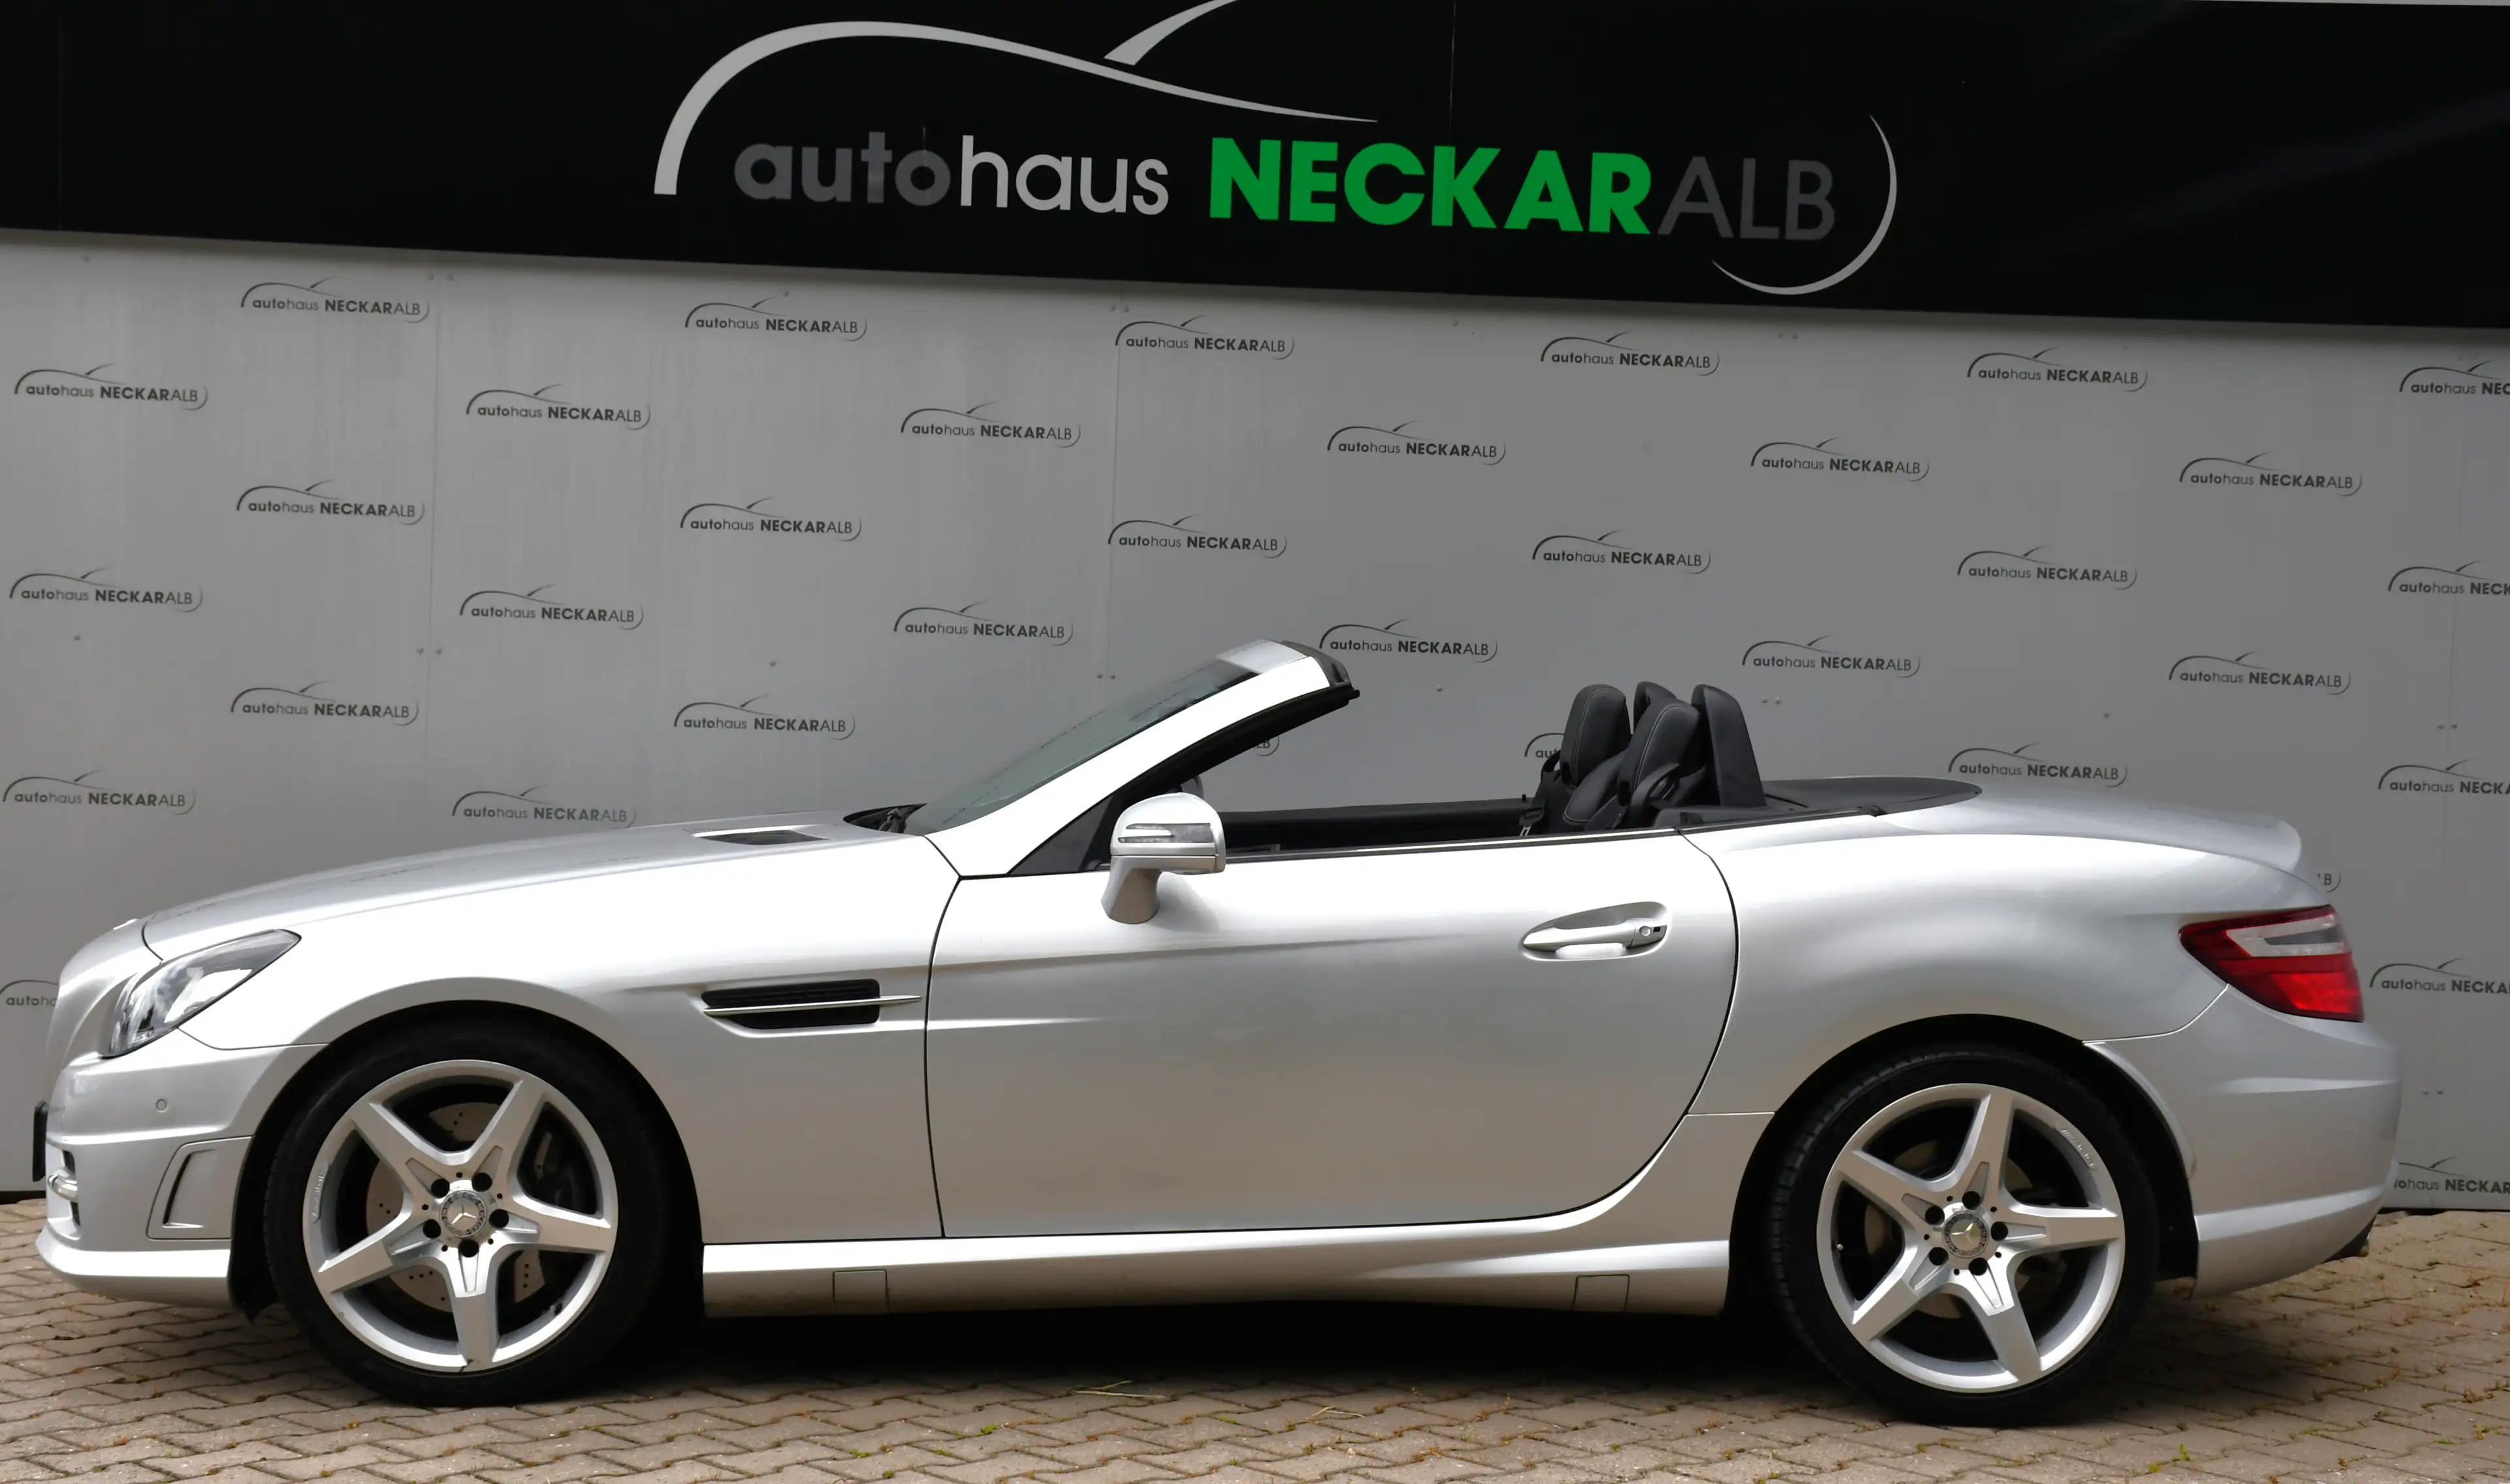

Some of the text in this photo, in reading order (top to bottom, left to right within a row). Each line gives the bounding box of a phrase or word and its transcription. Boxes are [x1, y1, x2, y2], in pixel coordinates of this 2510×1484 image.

[734, 131, 1835, 240] autohaus NECKARALB
[252, 297, 421, 316] autohaus NECKARALB
[695, 317, 858, 334] autohaus NECKARALB
[1125, 336, 1286, 353] autohaus NECKARALB
[1550, 352, 1711, 369] autohaus NECKARALB
[1977, 368, 2139, 385] autohaus NECKARALB
[24, 384, 199, 403] autohaus NECKARALB
[2410, 382, 2476, 394] autohaus
[477, 404, 642, 423] autohaus NECKARALB
[911, 423, 1073, 440] autohaus NECKARALB
[1337, 441, 1498, 458] autohaus NECKARALB
[1761, 457, 1921, 474] autohaus NECKARALB
[2190, 472, 2353, 489] autohaus NECKARALB
[247, 500, 416, 518] autohaus NECKARALB
[690, 518, 853, 535] autohaus NECKARALB
[1118, 535, 1278, 552] autohaus NECKARALB
[1543, 550, 1702, 567] autohaus NECKARALB
[1968, 566, 2128, 583] autohaus NECKARALB
[20, 588, 193, 605] autohaus NECKARALB
[2398, 582, 2465, 594] autohaus
[471, 606, 635, 623] autohaus NECKARALB
[904, 621, 1065, 639] autohaus NECKARALB
[1330, 639, 1489, 656] autohaus NECKARALB
[1752, 655, 1912, 672] autohaus NECKARALB
[2179, 670, 2342, 688] autohaus NECKARALB
[241, 702, 410, 719] autohaus NECKARALB
[683, 717, 846, 733] autohaus NECKARALB
[1958, 763, 2119, 781] autohaus NECKARALB
[2389, 780, 2454, 793] autohaus
[14, 791, 186, 807] autohaus NECKARALB
[463, 806, 628, 823] autohaus NECKARALB
[2381, 979, 2510, 994] autohaus NECKA
